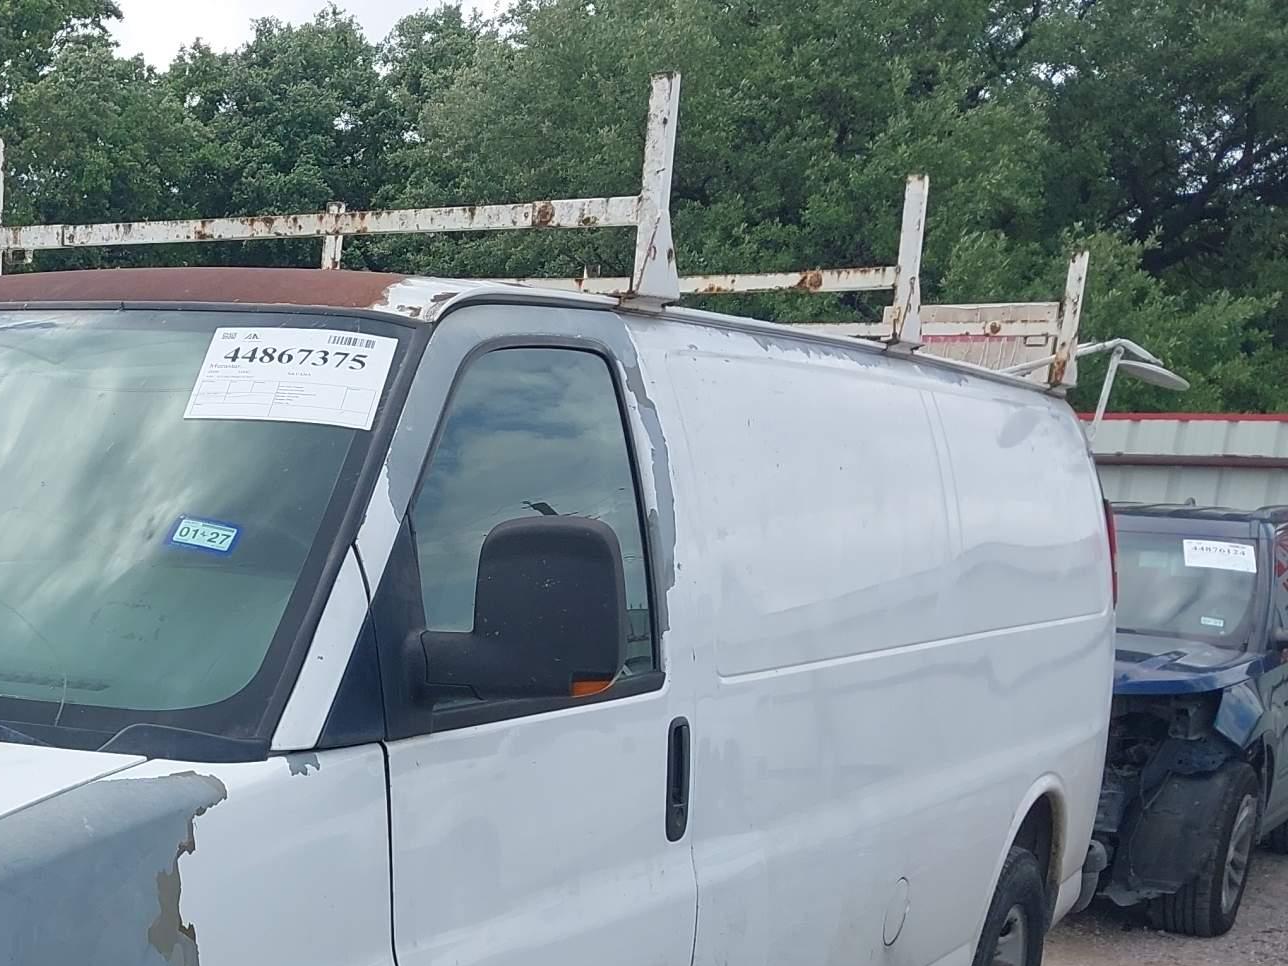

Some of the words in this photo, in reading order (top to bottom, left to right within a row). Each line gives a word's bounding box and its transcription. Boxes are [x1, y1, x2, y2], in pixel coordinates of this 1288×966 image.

[223, 346, 369, 370] 44867375
[179, 526, 200, 539] 01
[207, 532, 231, 545] 27
